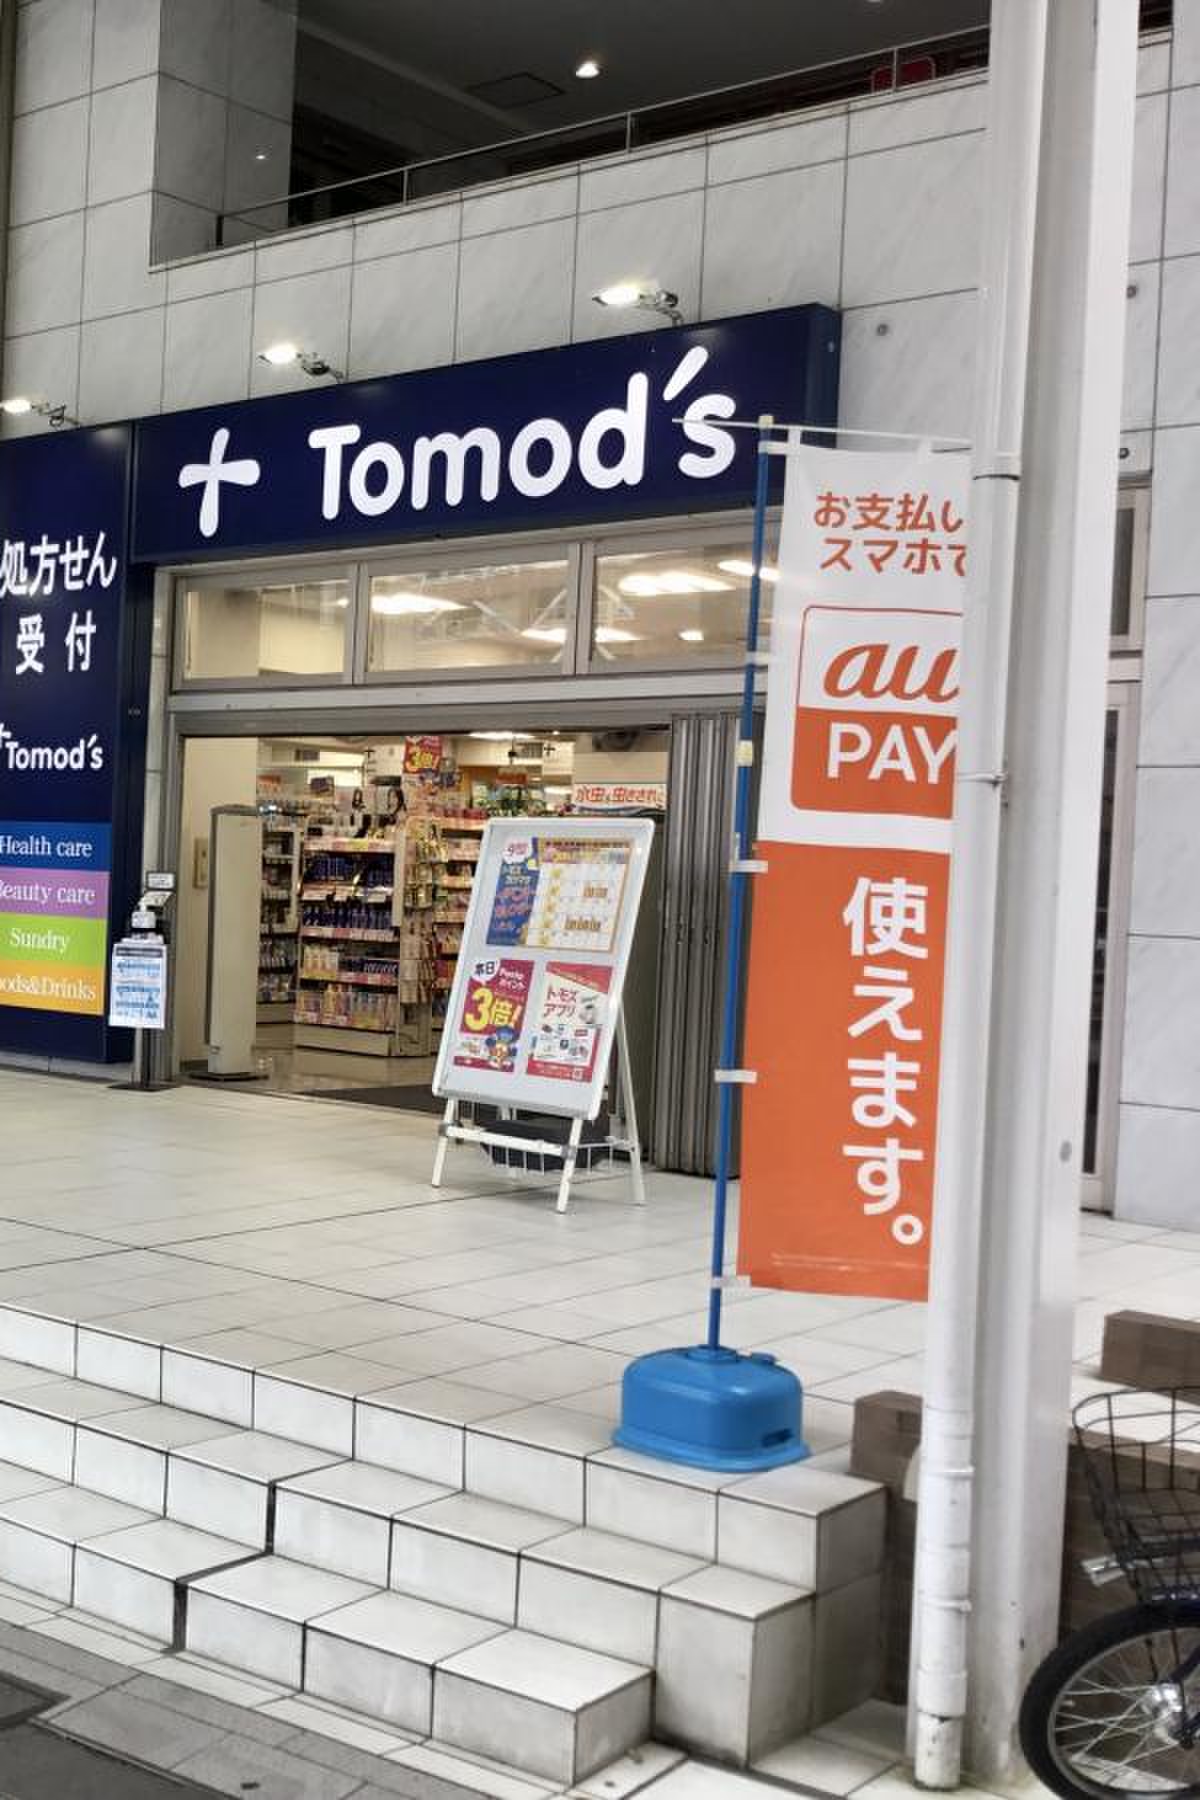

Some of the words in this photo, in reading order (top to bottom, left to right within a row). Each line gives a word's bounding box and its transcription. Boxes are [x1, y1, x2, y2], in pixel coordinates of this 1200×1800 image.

[309, 346, 736, 520] Tomod's
[0, 530, 117, 599] 処方せん
[15, 609, 97, 675] 受付
[823, 643, 960, 703] au
[5, 733, 104, 770] Tomod's
[826, 722, 958, 785] PAY
[0, 834, 51, 857] Health
[56, 841, 93, 858] care
[56, 886, 96, 905] care
[9, 927, 71, 954] Sundry
[464, 986, 523, 1032] 3倍!
[843, 876, 929, 1245] 使えます。
